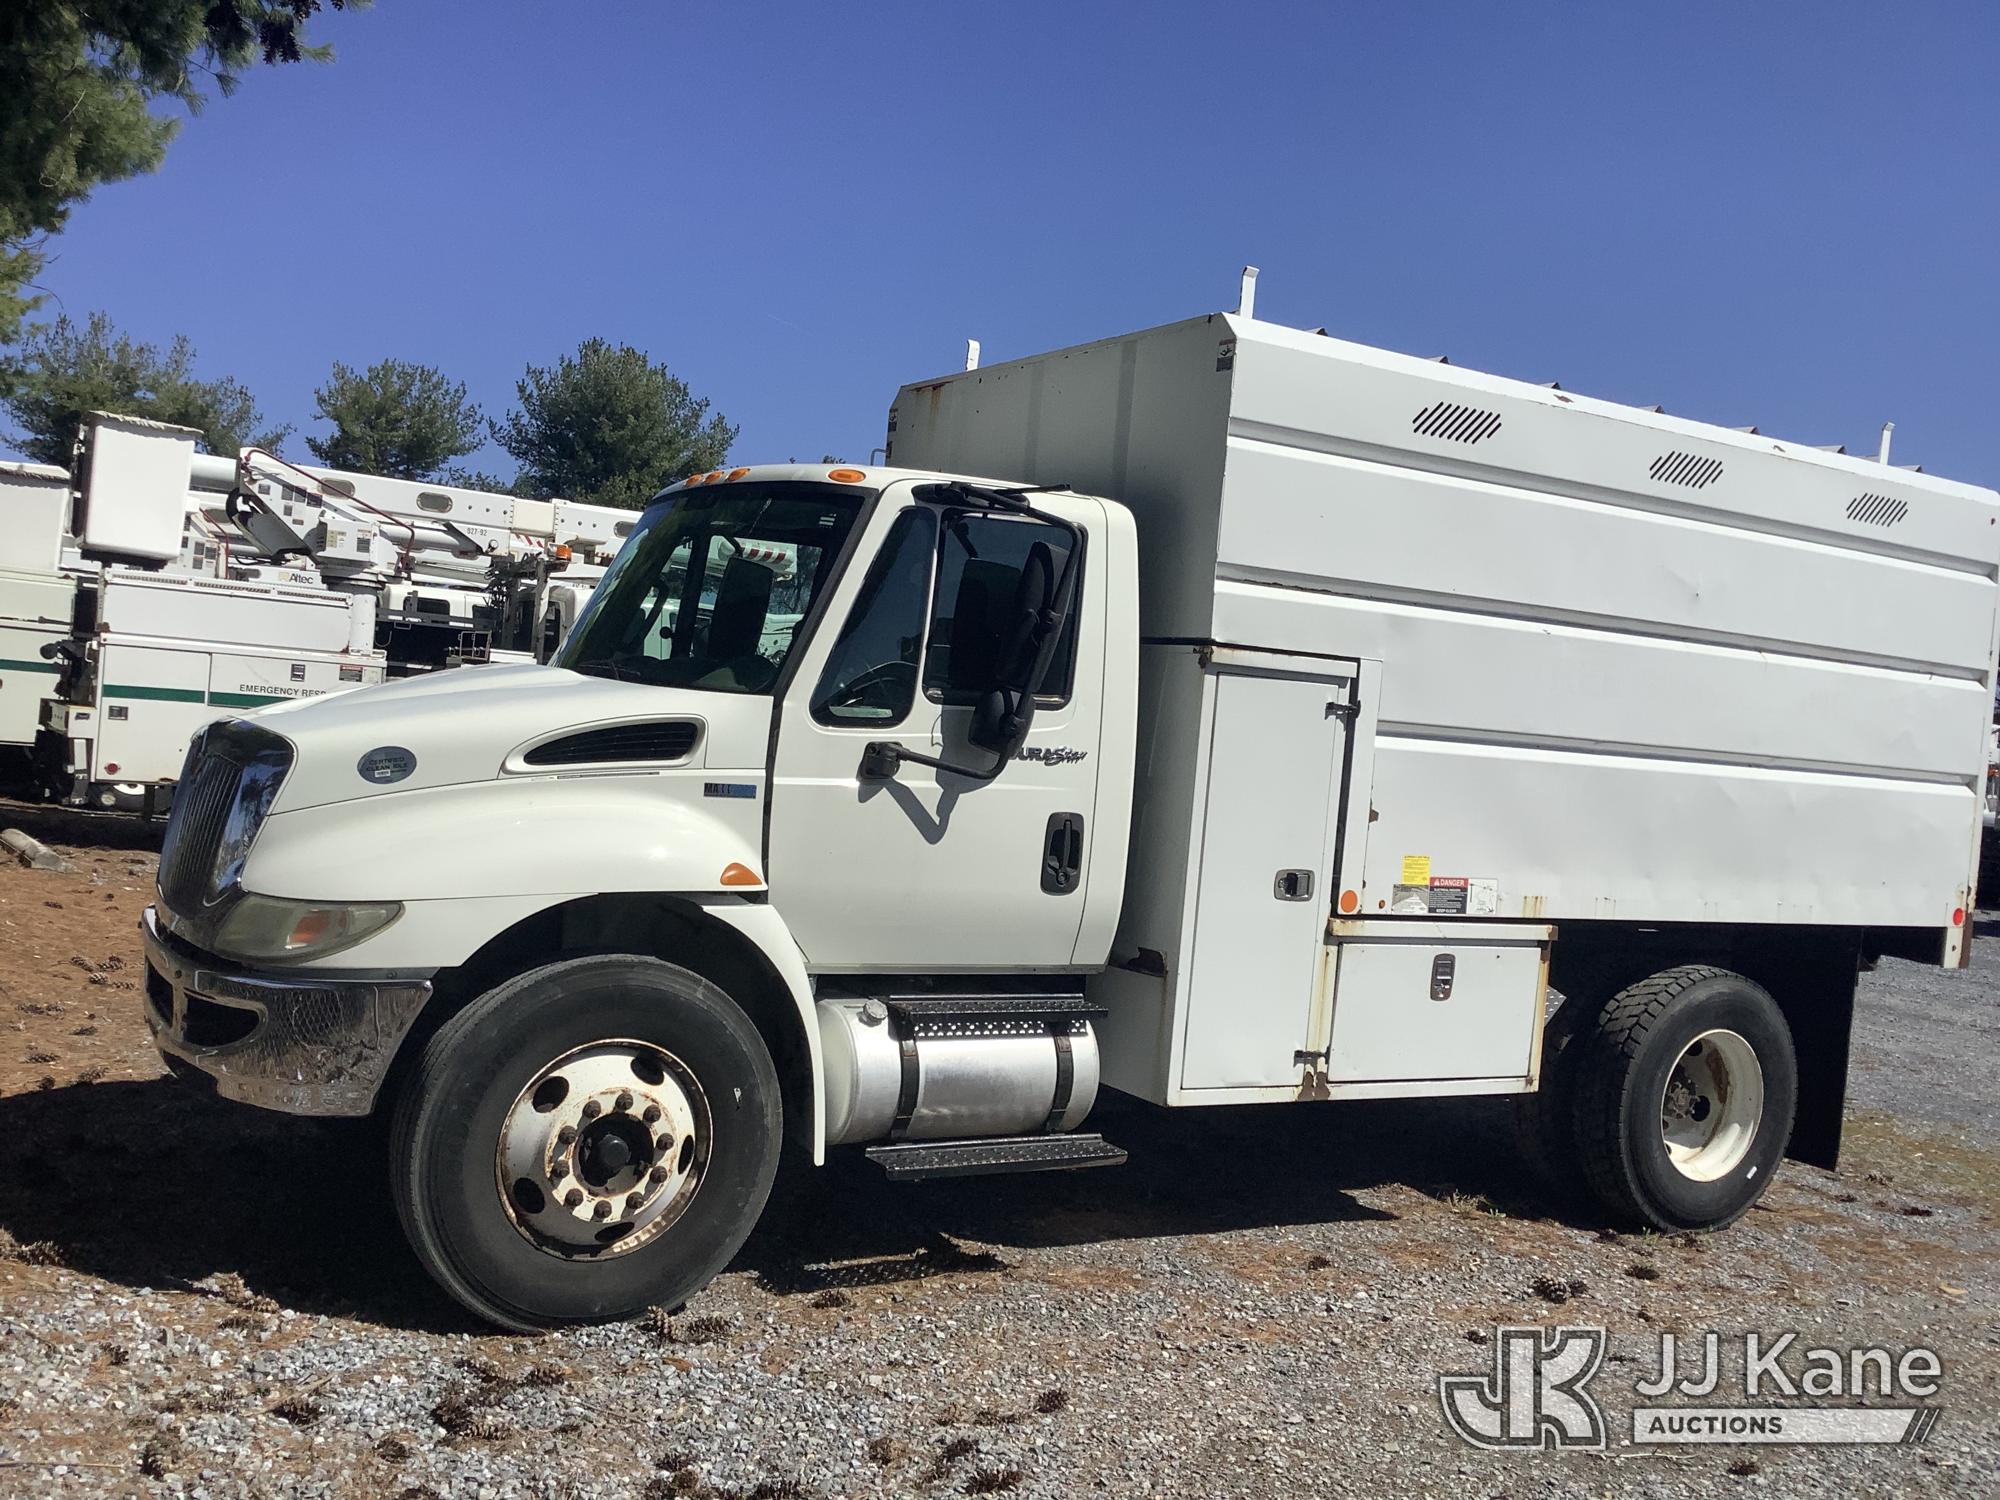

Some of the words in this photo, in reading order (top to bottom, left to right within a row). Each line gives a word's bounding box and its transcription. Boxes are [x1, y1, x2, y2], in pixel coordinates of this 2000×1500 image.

[289, 573, 314, 585] Altec
[239, 684, 300, 696] EMERGENCY
[366, 763, 391, 772] CLEAN
[1440, 878, 1465, 887] DANGER
